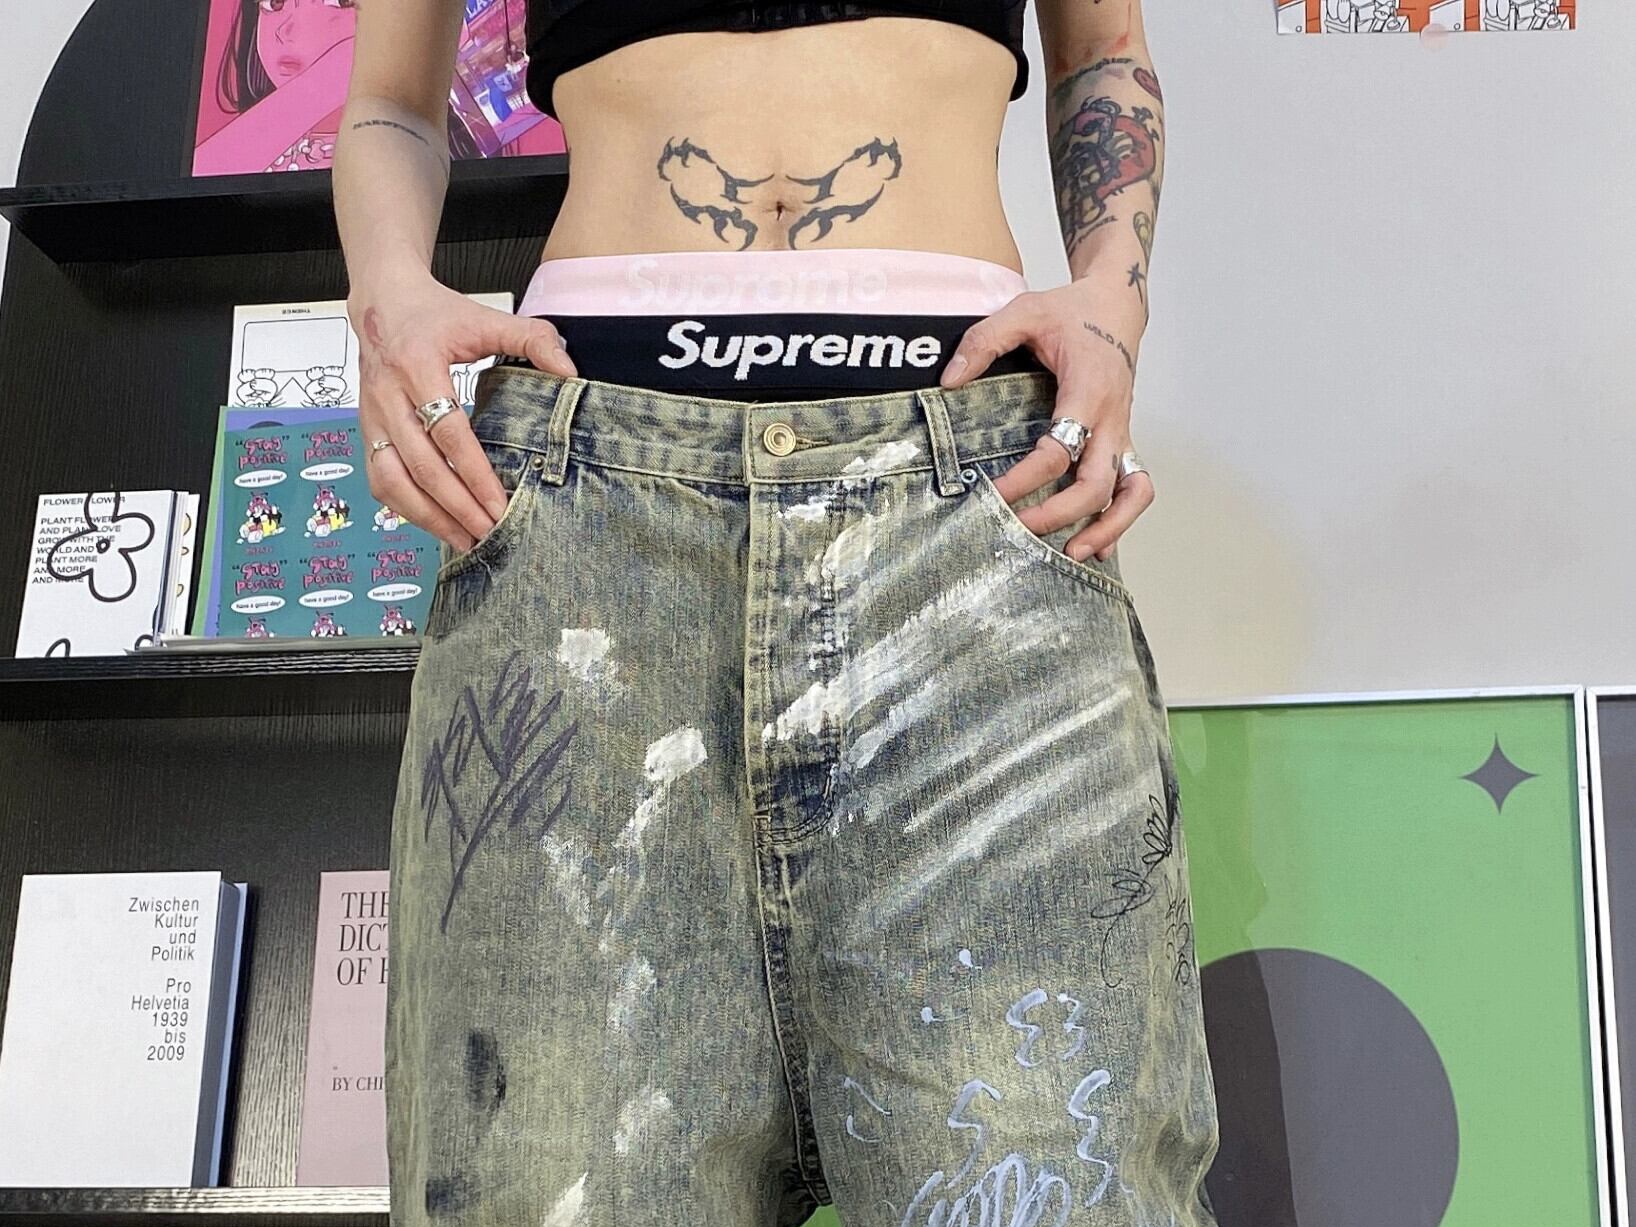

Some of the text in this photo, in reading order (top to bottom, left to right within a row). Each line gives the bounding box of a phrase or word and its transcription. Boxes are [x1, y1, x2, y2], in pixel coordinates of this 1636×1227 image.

[658, 320, 941, 380] Supreme
[43, 497, 84, 507] FLOWER
[41, 517, 75, 525] PLANT
[39, 527, 60, 535] AND
[74, 545, 95, 553] AND
[69, 555, 97, 564] MORE
[32, 576, 53, 584] AND
[128, 896, 199, 912] Zwischen
[154, 912, 199, 928] Kultur
[169, 929, 196, 944] und
[151, 945, 195, 961] Politik
[336, 957, 373, 986] OF
[165, 977, 191, 993] Pro
[131, 995, 189, 1010] Helvetia
[152, 1011, 188, 1027] 1939
[164, 1028, 186, 1044] bis
[147, 1045, 185, 1061] 2009
[332, 1076, 353, 1091] BY
